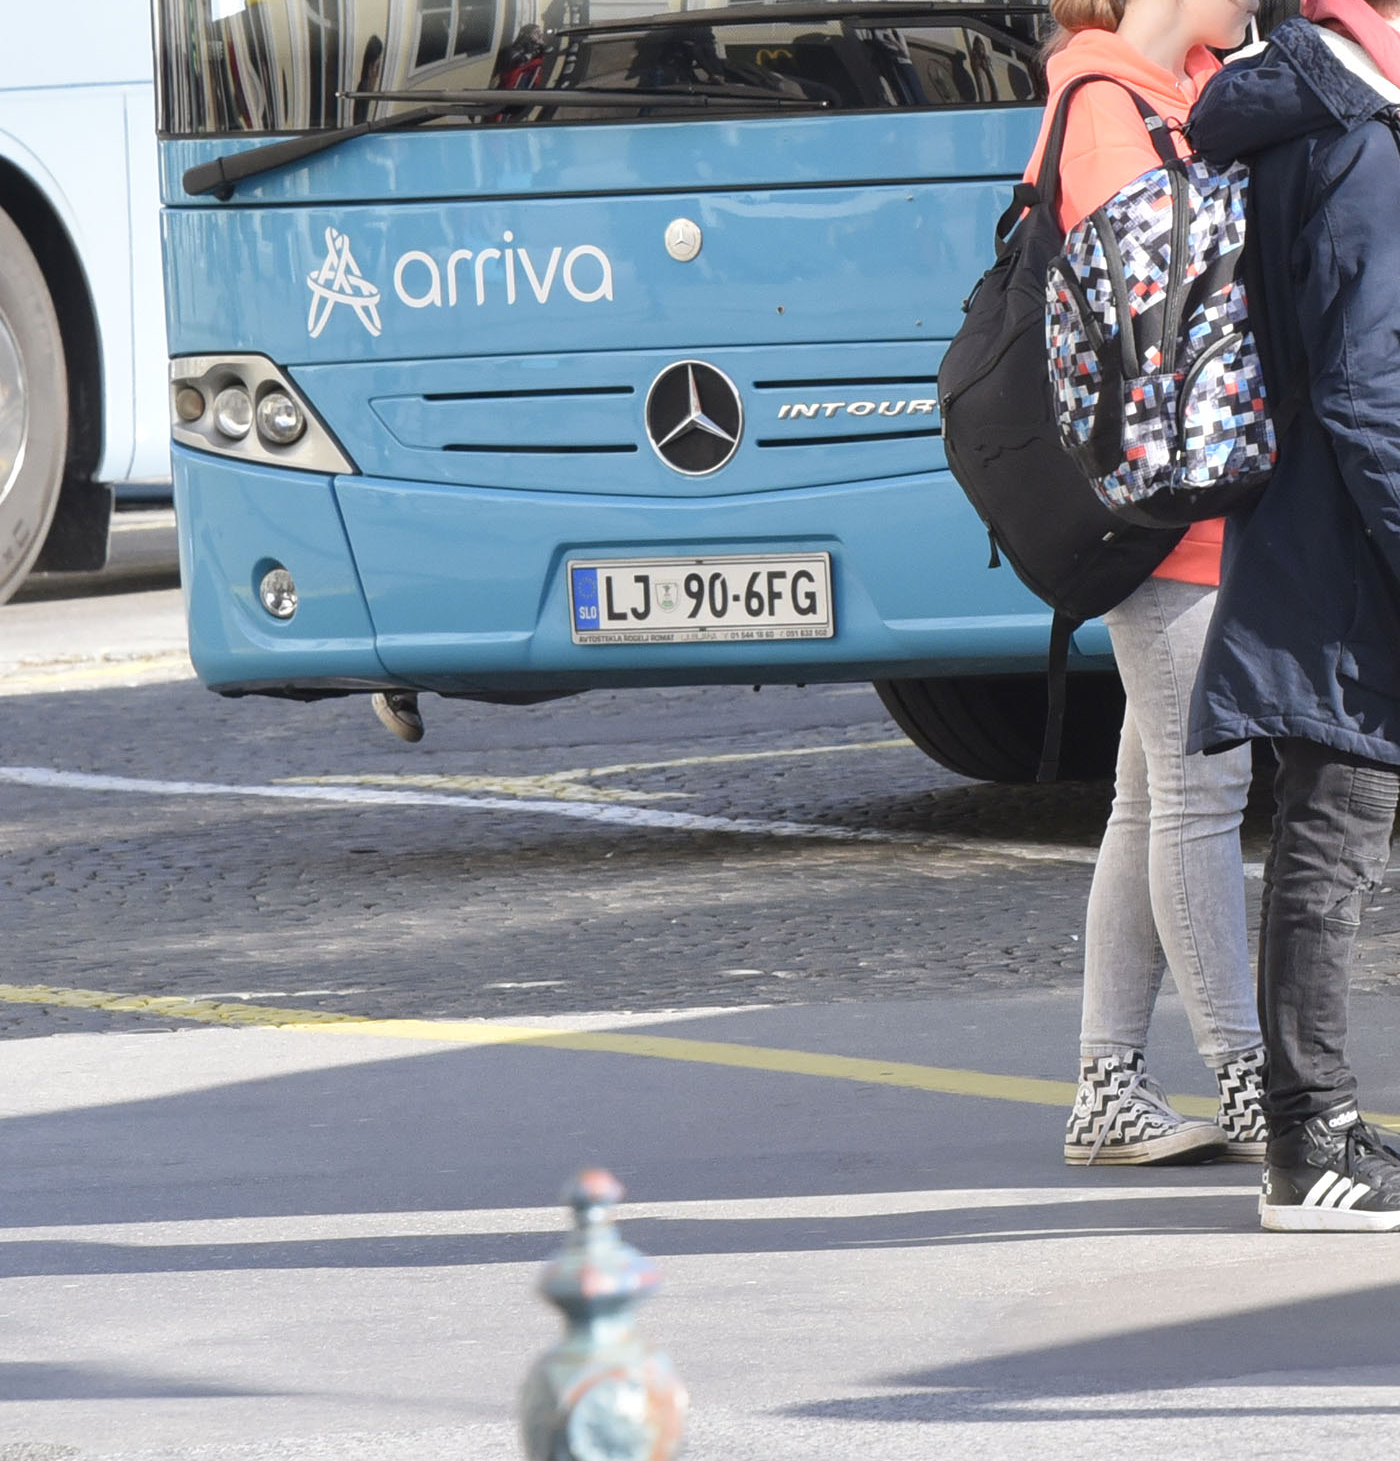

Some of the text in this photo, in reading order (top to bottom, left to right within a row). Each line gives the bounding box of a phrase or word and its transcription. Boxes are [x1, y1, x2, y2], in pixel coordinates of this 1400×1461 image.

[393, 231, 613, 309] arriva
[778, 399, 941, 420] INTOUR
[579, 605, 597, 620] SLO
[605, 569, 818, 621] LJ 90-6FG
